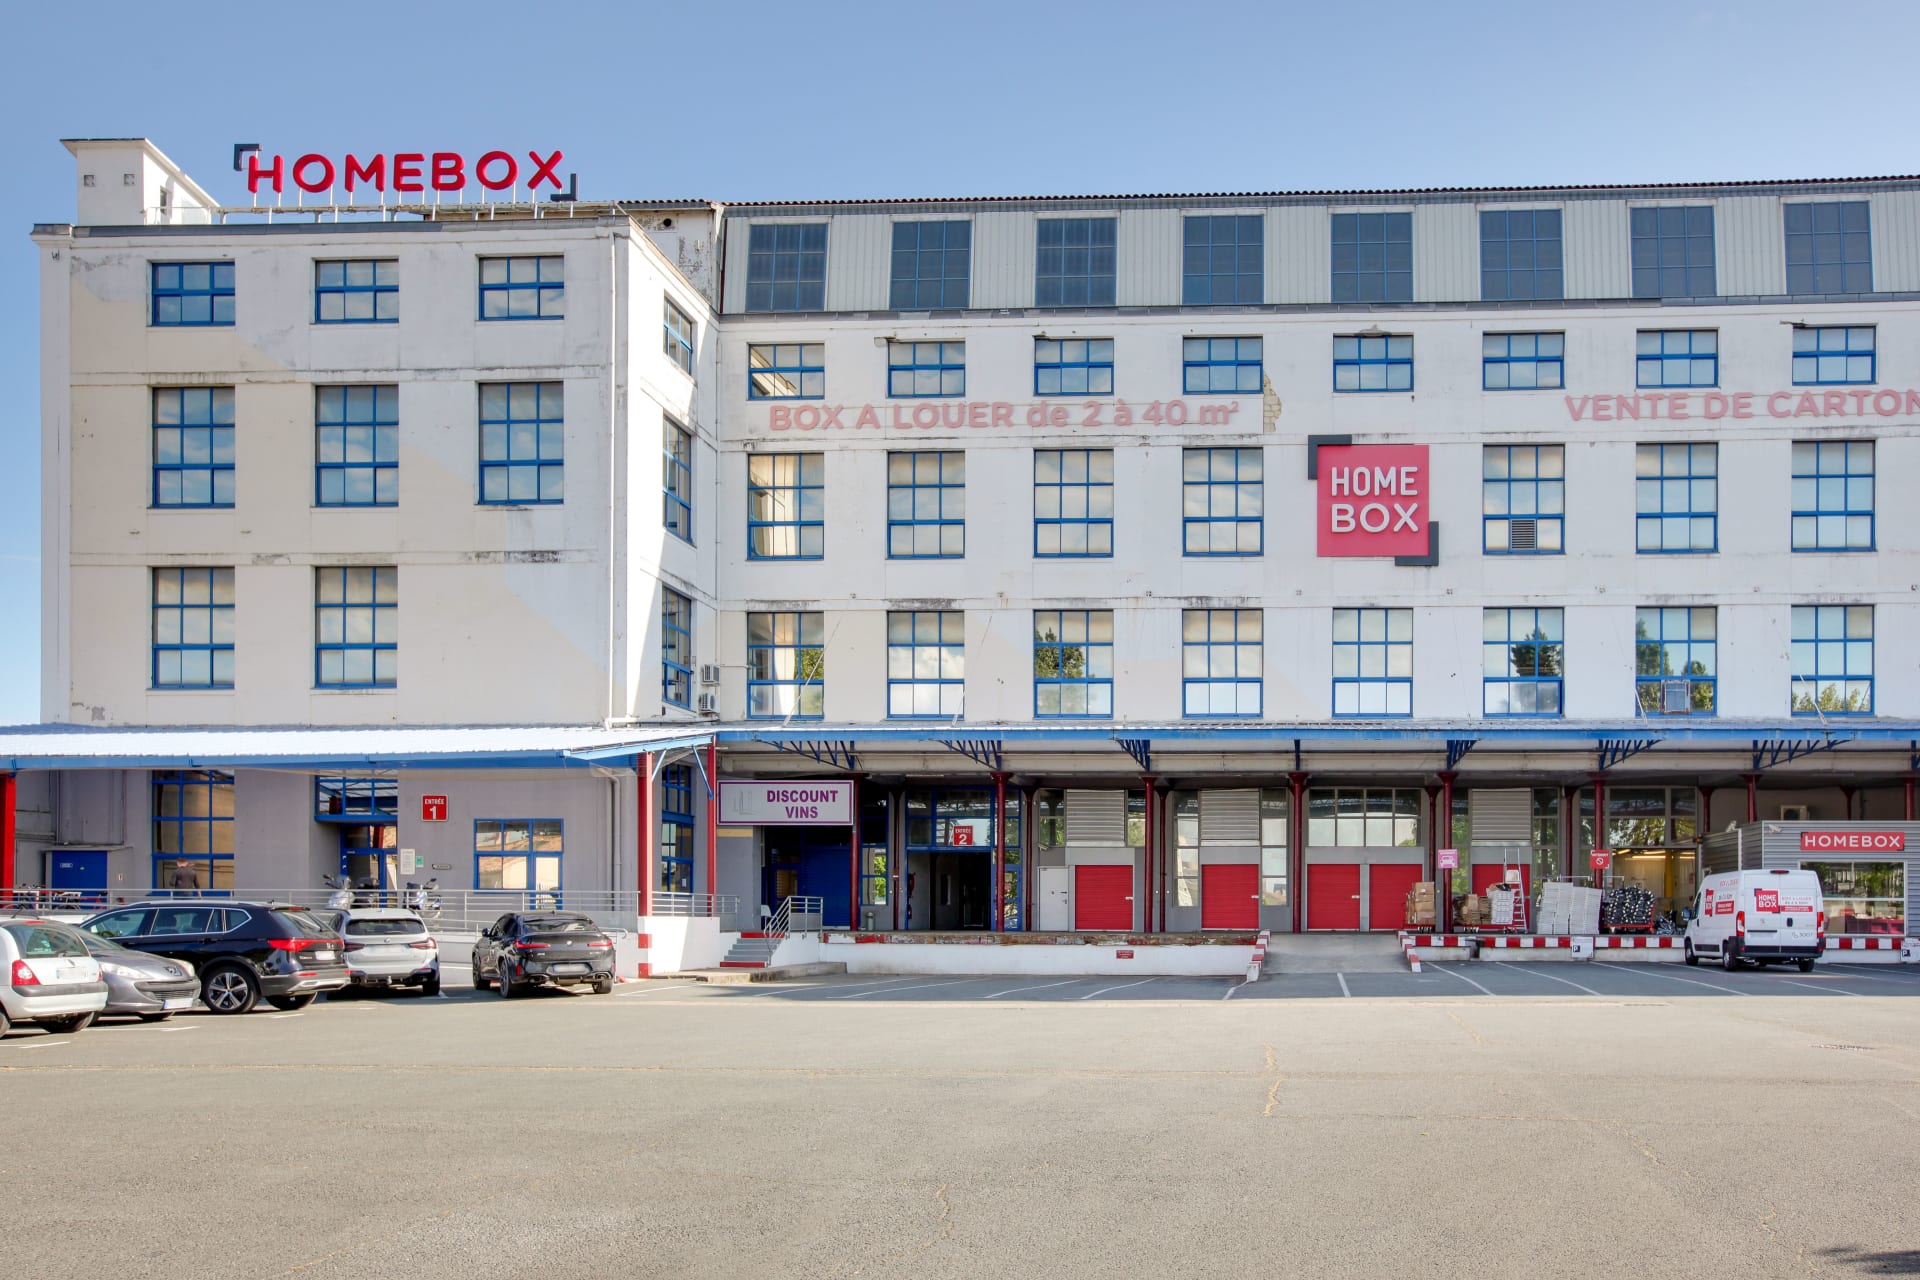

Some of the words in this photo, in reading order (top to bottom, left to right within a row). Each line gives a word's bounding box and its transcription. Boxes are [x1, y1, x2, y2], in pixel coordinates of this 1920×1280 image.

[248, 150, 564, 193] HOMEBOX
[769, 405, 844, 431] BOX
[855, 405, 881, 429] A
[893, 402, 1014, 429] LOUER
[1026, 401, 1069, 428] de
[1081, 401, 1103, 427] 2
[1116, 399, 1132, 427] à
[1142, 400, 1188, 426] 40
[1565, 393, 1690, 421] VENTE
[1704, 392, 1754, 419] DE
[1766, 388, 1920, 418] CARTON
[1331, 466, 1418, 496] HOME
[1331, 503, 1419, 533] BOX
[767, 790, 838, 802] DISCOUNT
[430, 806, 437, 820] 1
[785, 806, 818, 818] VINS
[959, 834, 967, 845] 2
[1804, 835, 1900, 848] HOMEBOX
